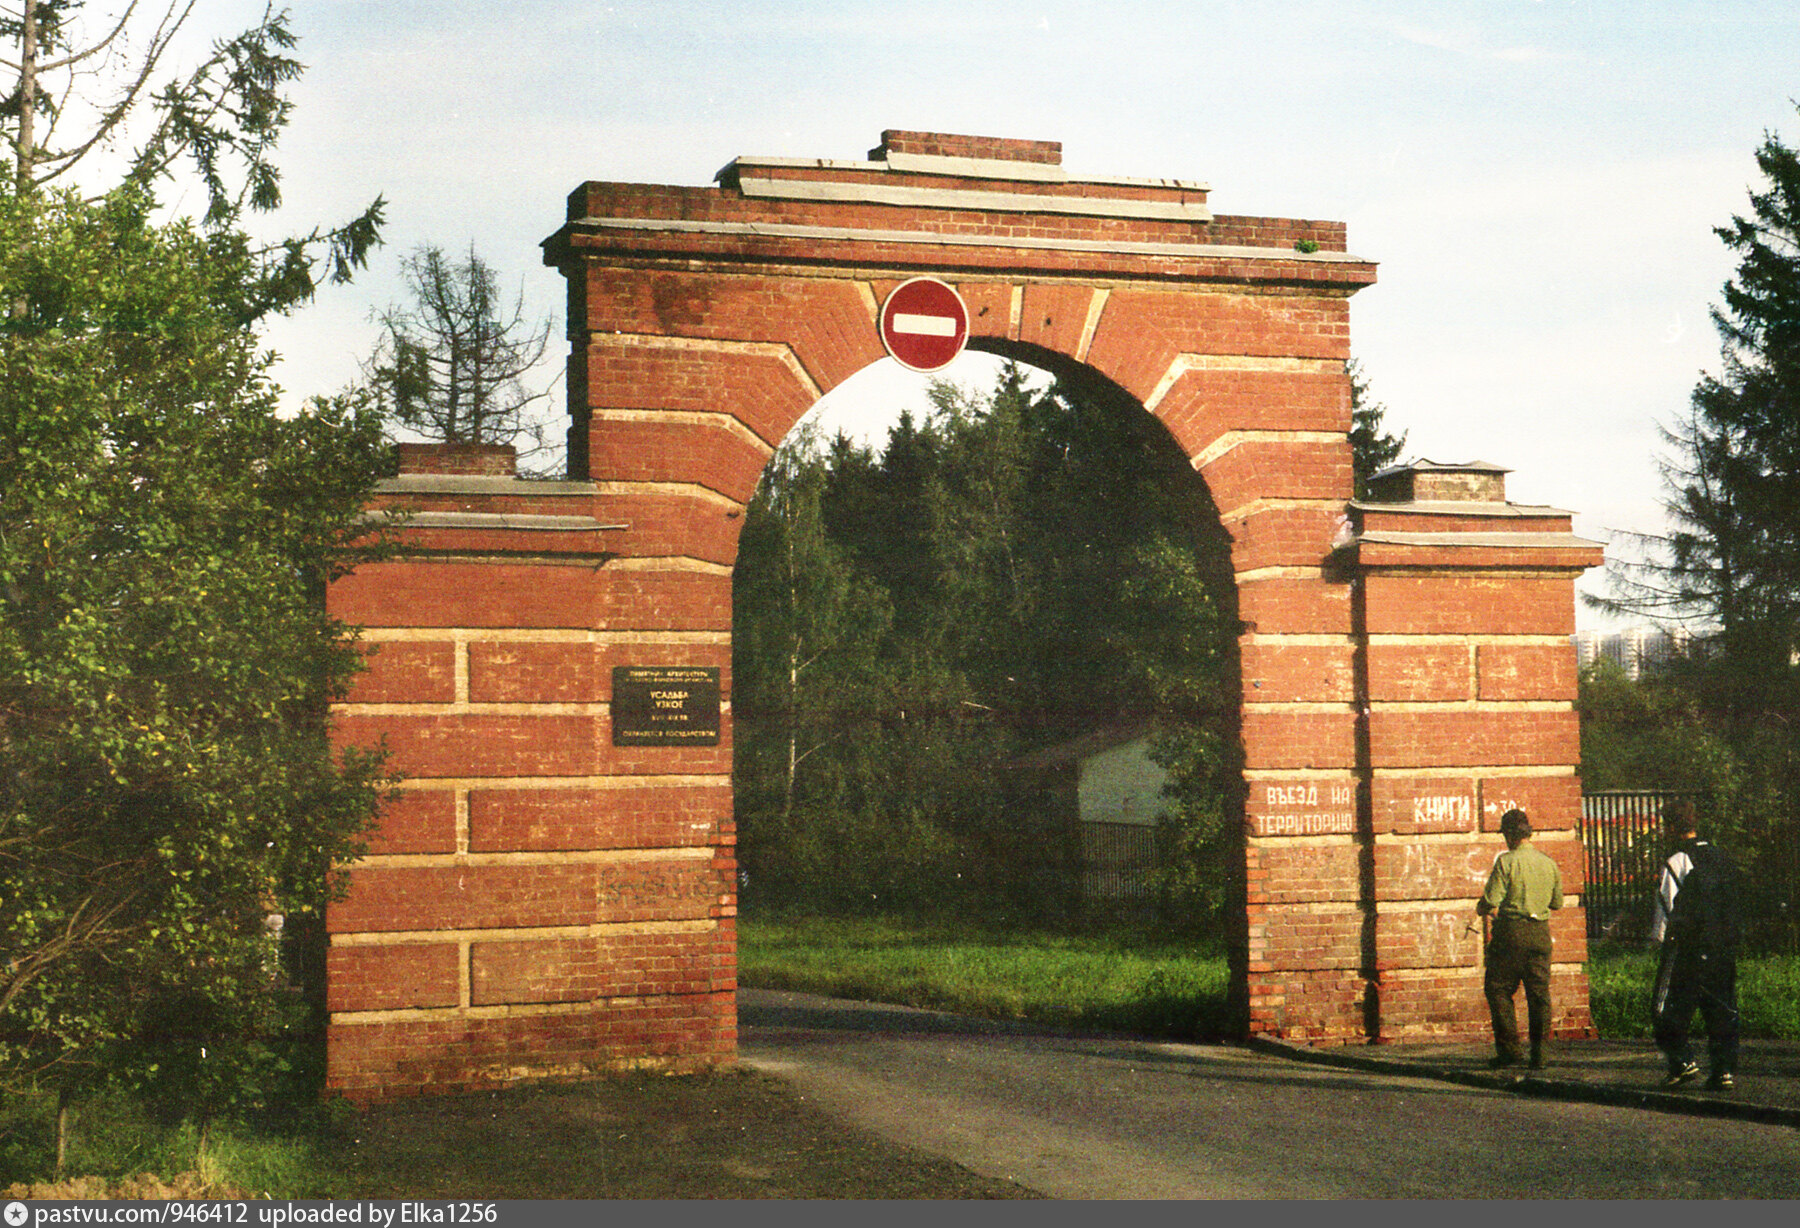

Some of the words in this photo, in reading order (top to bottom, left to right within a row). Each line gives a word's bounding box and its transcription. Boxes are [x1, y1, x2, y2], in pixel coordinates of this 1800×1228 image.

[650, 691, 689, 699] УСАДЬБА
[656, 700, 683, 708] УЗКОЕ
[1267, 786, 1318, 806] ВЪЕЗД
[1331, 786, 1350, 805] НА
[1413, 796, 1470, 823] КНИГИ
[1257, 813, 1353, 834] ТЕРРИТОРИЮ
